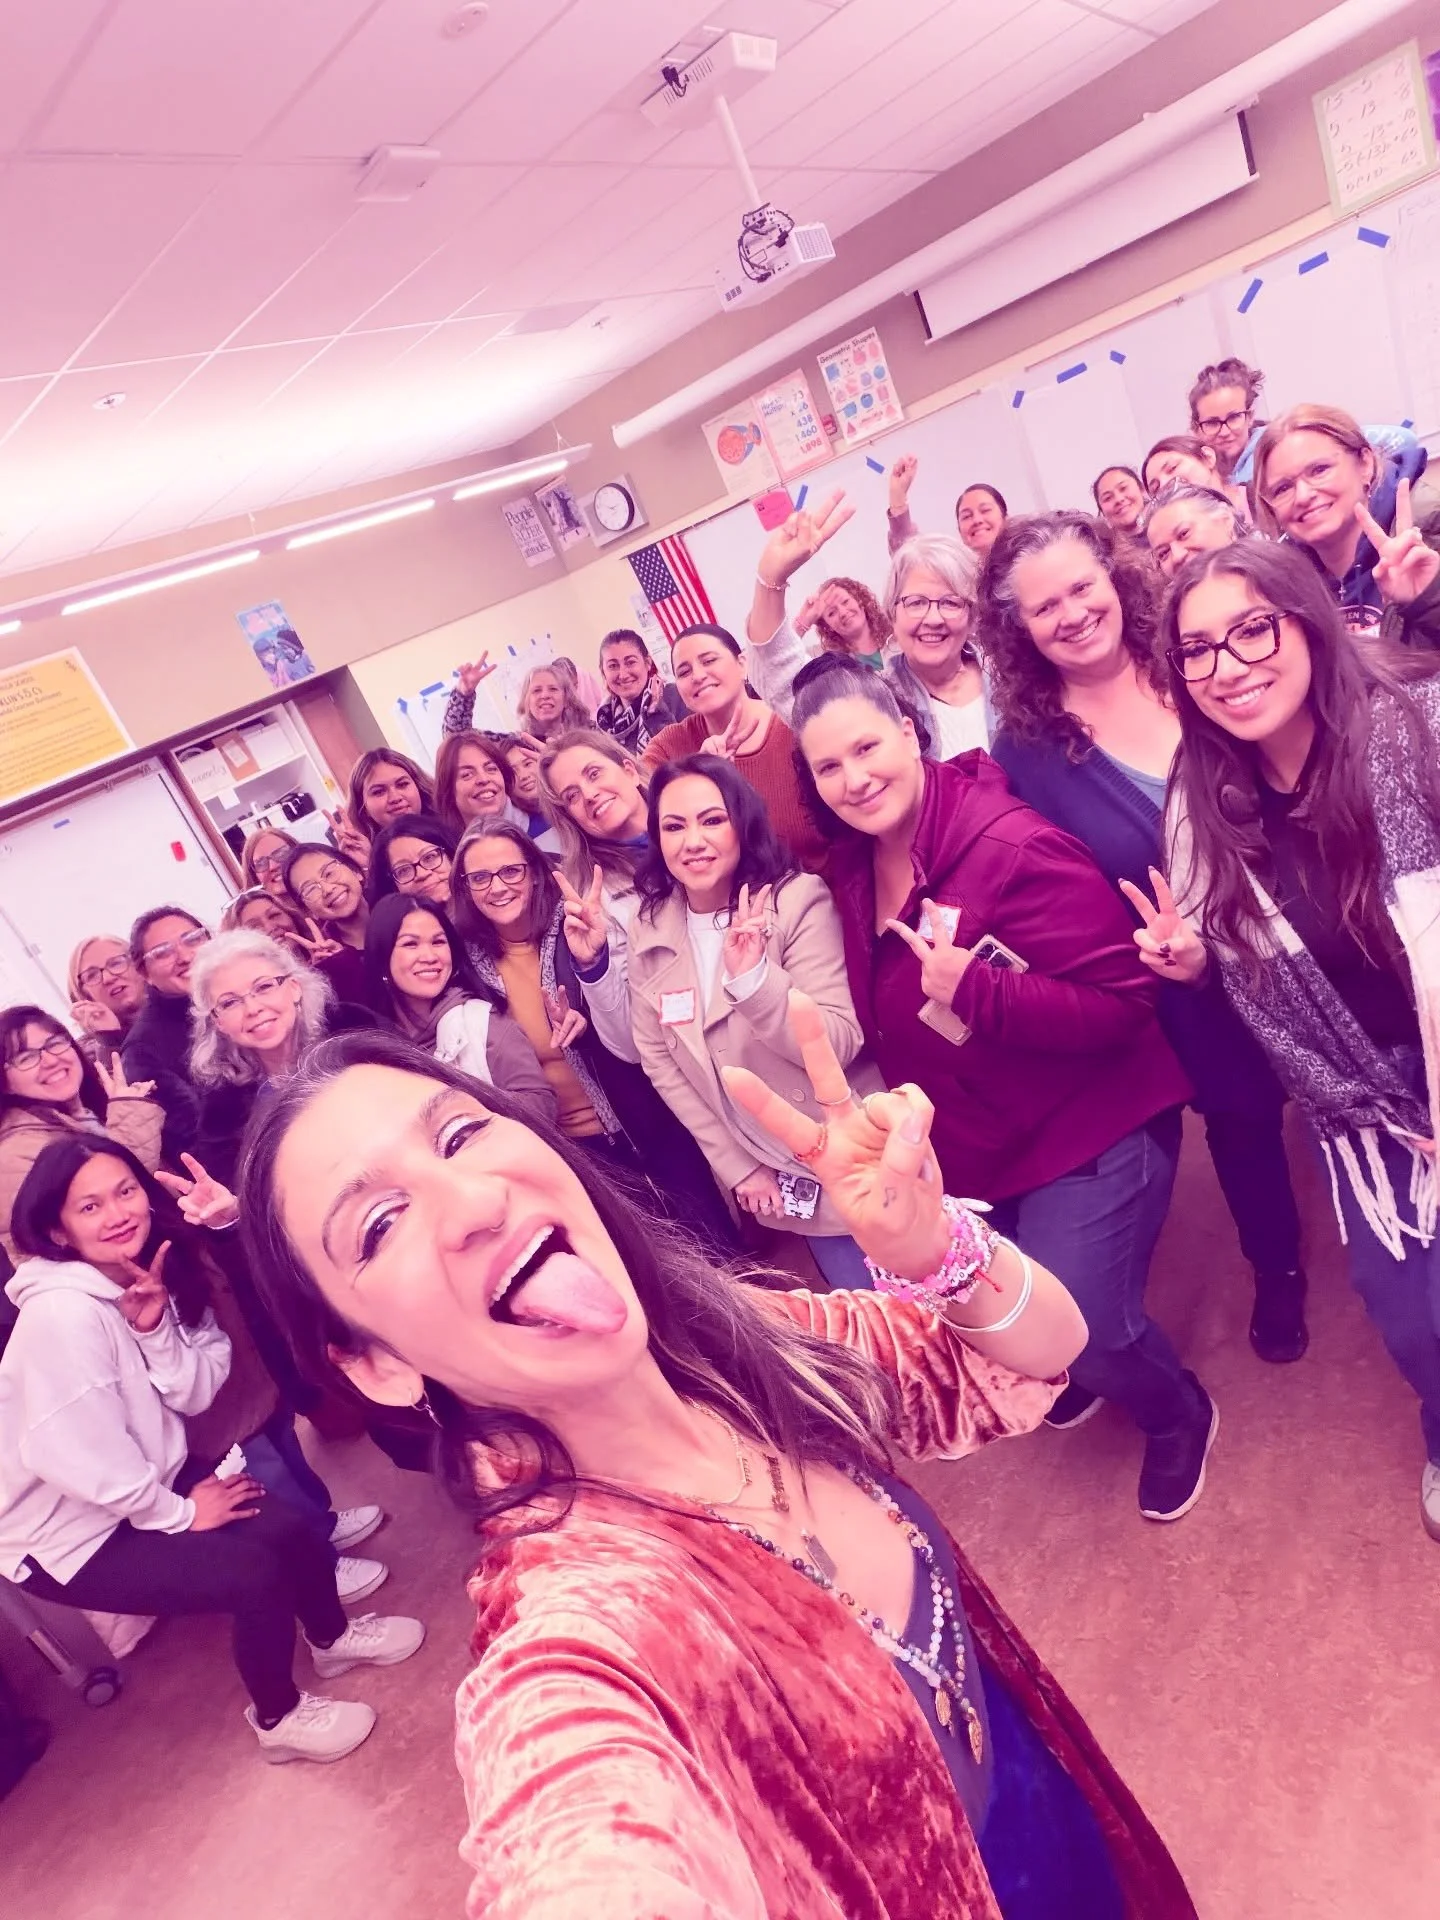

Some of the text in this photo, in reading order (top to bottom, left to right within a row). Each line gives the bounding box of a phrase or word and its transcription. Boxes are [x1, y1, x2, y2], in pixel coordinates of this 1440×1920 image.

[820, 332, 875, 364] Geometric Shapes
[797, 414, 813, 427] 438
[505, 505, 535, 527] People
